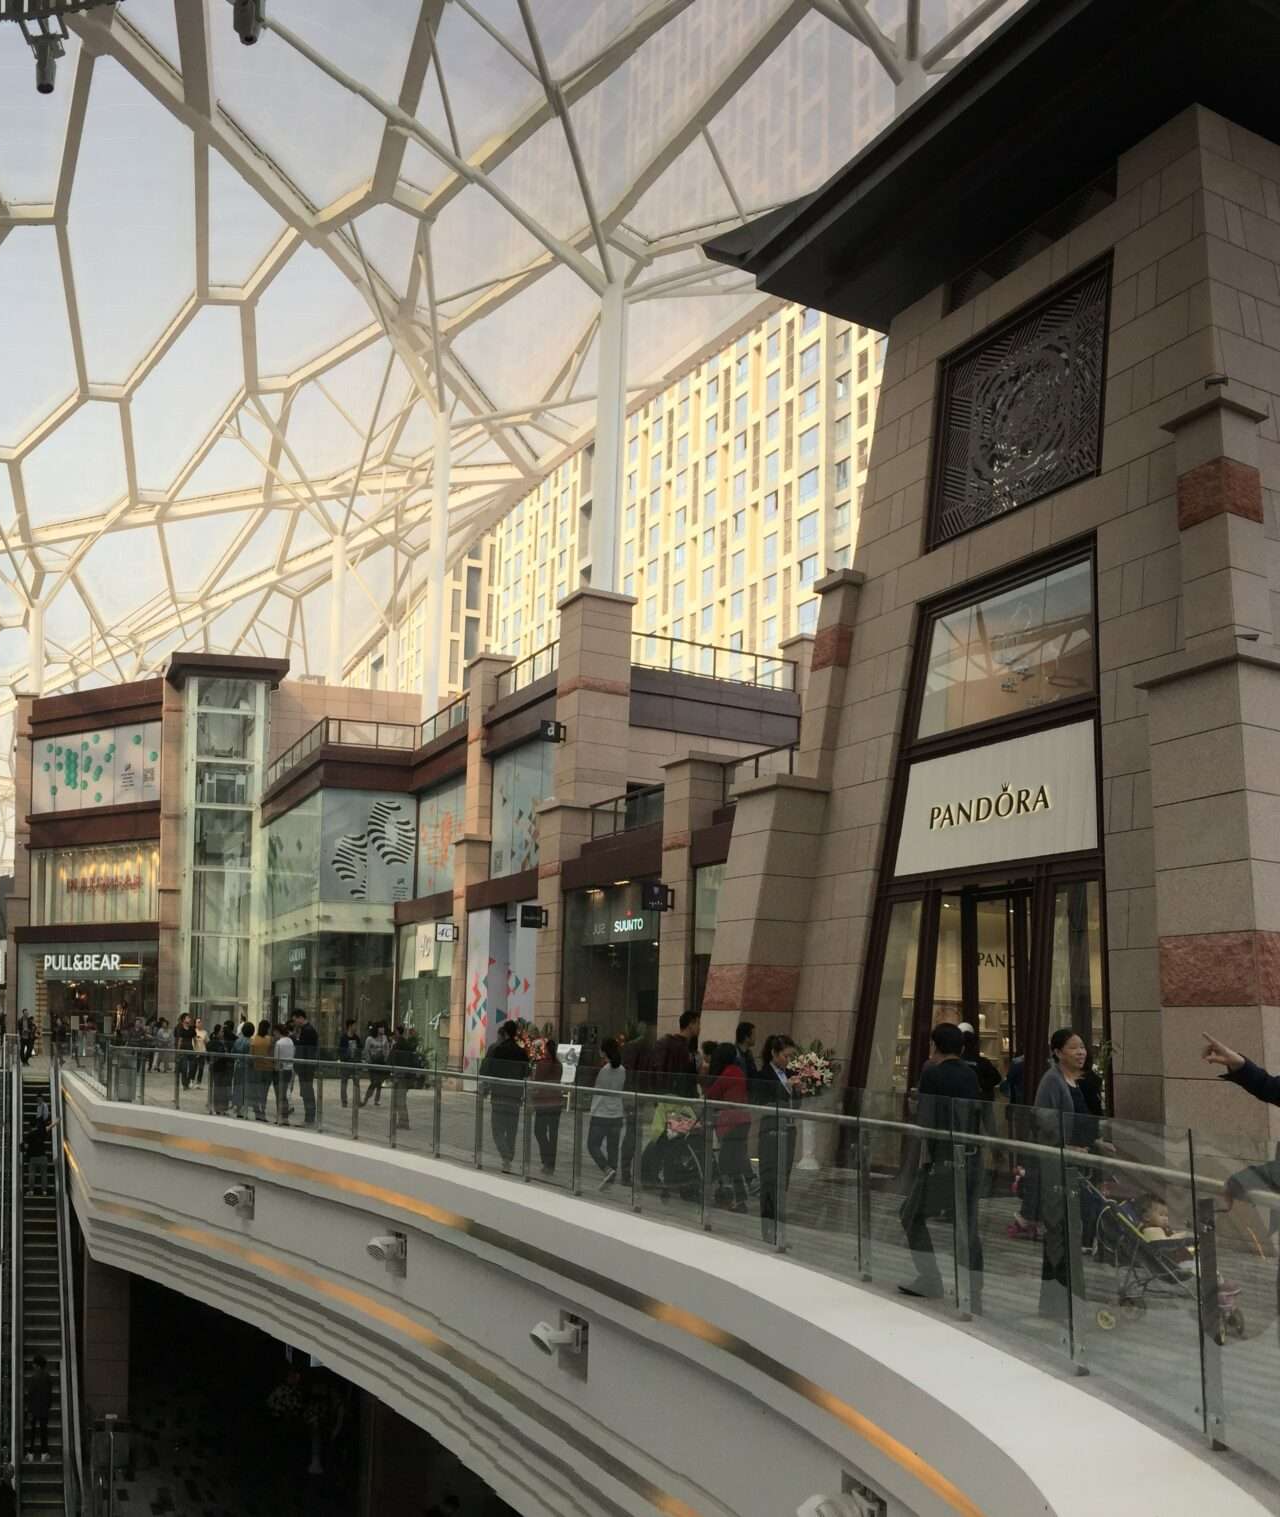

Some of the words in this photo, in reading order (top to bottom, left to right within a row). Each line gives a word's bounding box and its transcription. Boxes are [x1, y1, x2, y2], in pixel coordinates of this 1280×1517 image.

[929, 782, 1050, 830] PANDORA
[614, 918, 643, 932] SUUNTO
[44, 954, 120, 970] PULL&BEAR
[977, 952, 1015, 968] PAN
